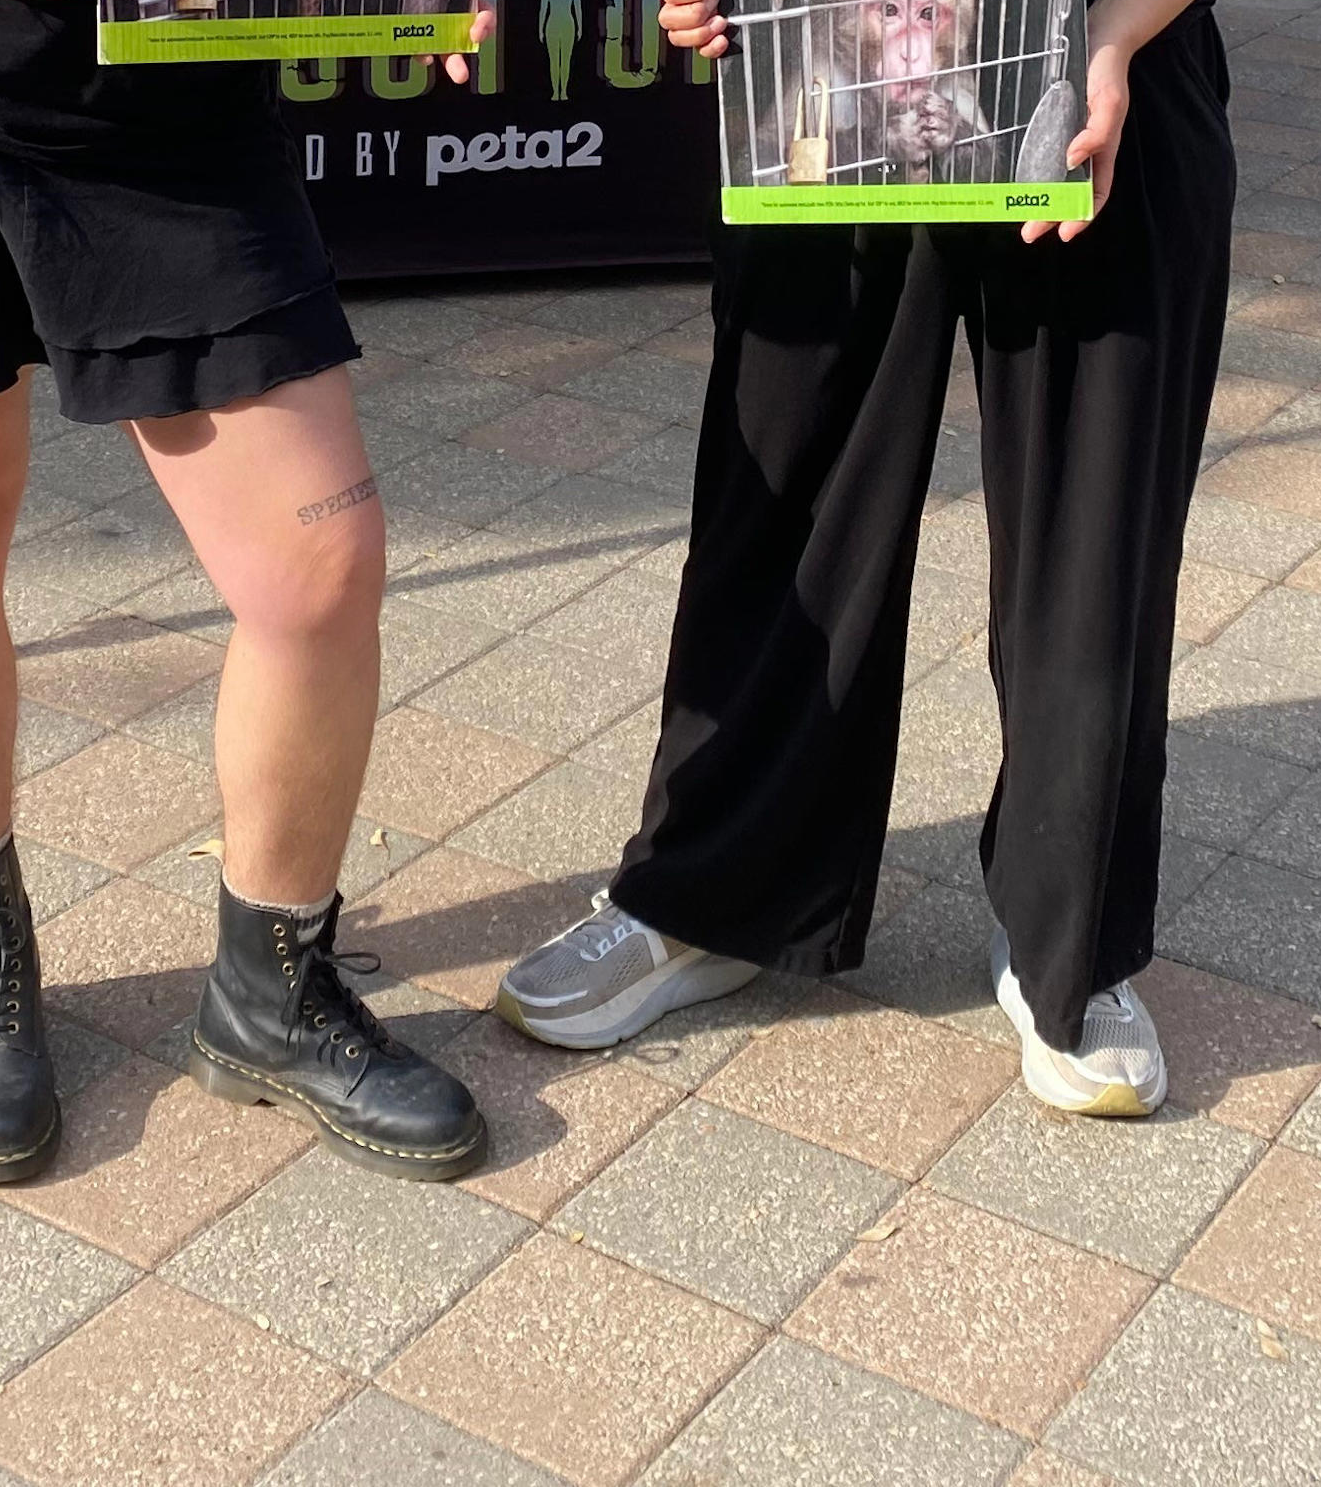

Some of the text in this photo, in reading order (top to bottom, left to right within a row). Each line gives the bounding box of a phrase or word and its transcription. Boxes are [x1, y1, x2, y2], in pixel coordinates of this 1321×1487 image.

[393, 24, 435, 42] peta2
[355, 129, 401, 177] BY
[425, 121, 604, 186] peta2
[1006, 193, 1050, 210] peta2
